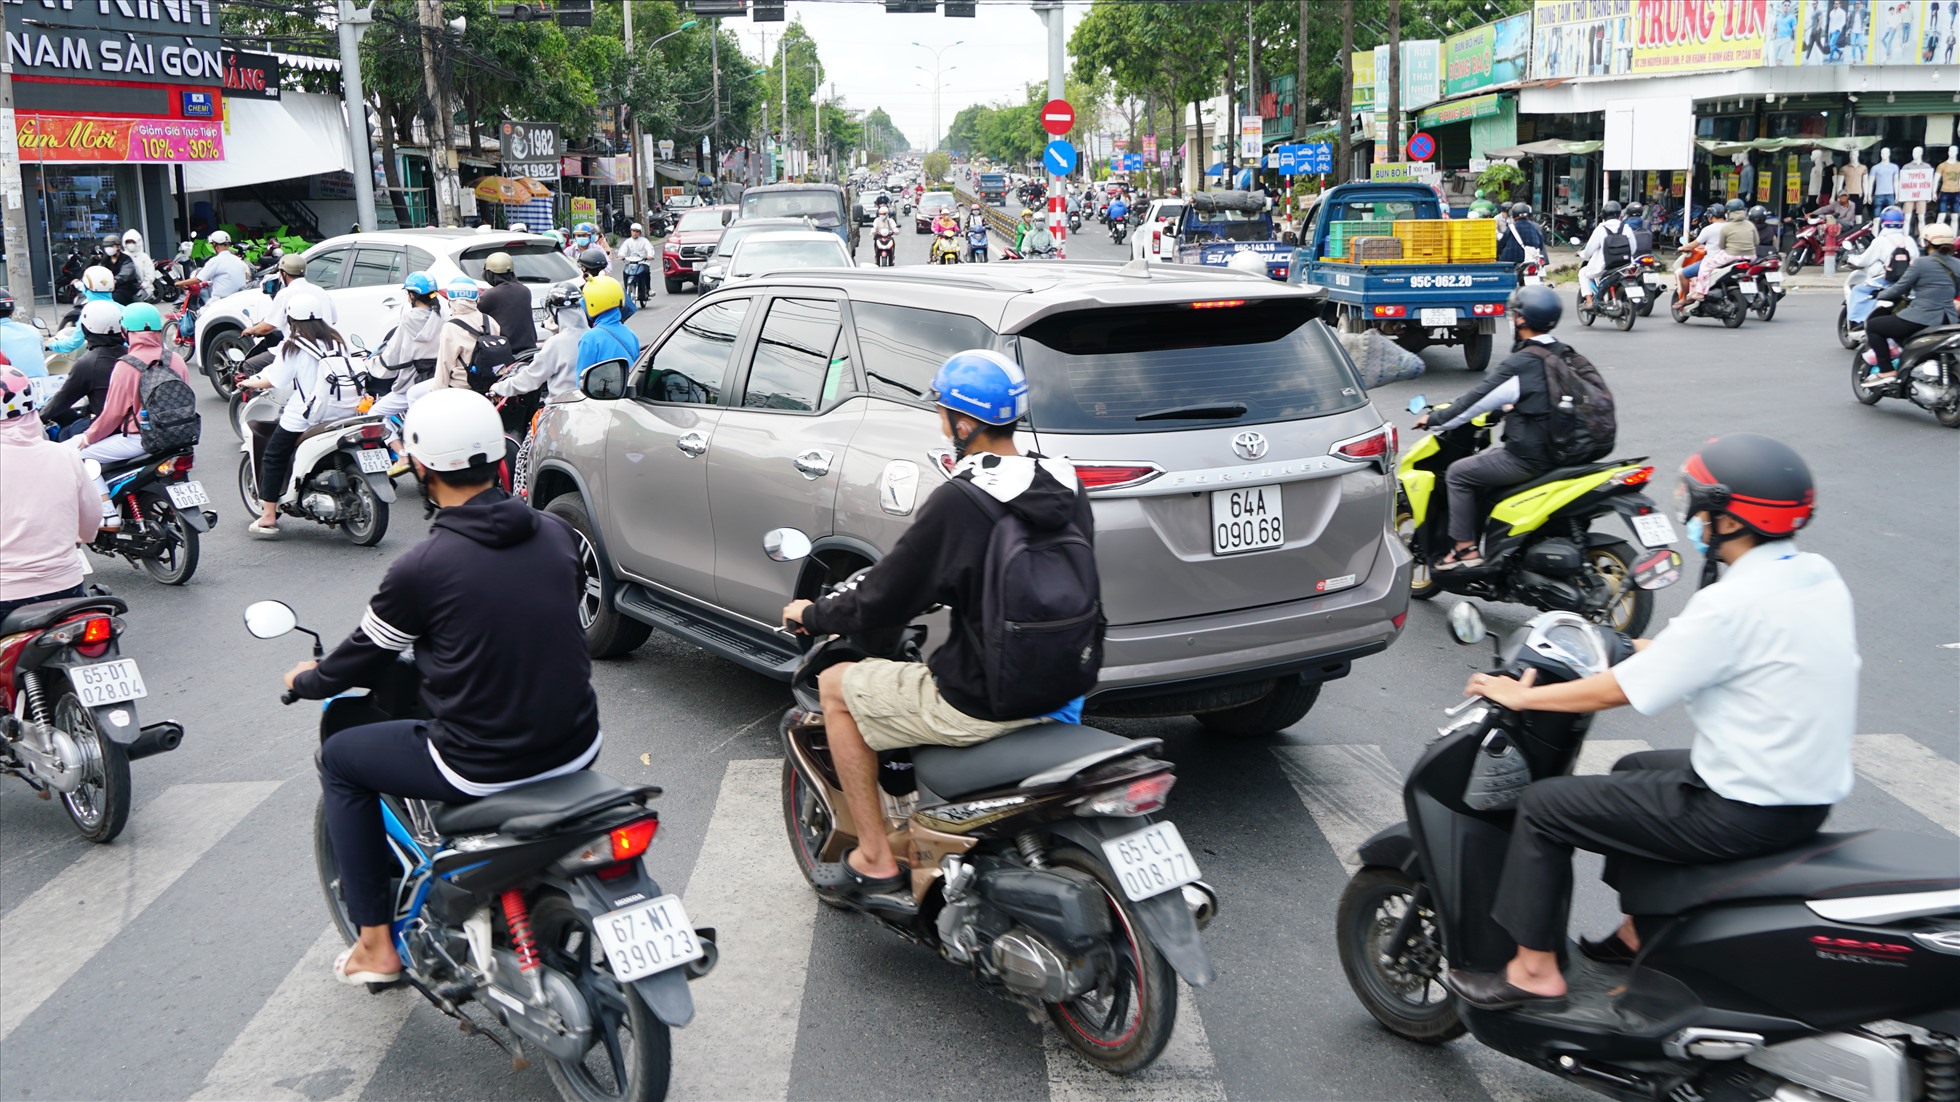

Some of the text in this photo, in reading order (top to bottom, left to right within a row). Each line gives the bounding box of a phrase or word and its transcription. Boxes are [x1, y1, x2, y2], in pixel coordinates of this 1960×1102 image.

[5, 31, 223, 78] NAM SÀI GÒN
[188, 104, 209, 112] CHEMI
[61, 121, 118, 148] Mới
[139, 124, 217, 138] Giảm Giá Trực Tiếp
[528, 128, 555, 156] 1982
[141, 138, 174, 159] 10%
[188, 139, 218, 159] 30%
[523, 163, 555, 177] 1982
[1410, 275, 1473, 288] 95C-062.20
[1172, 462, 1329, 486] FORTUNER
[1230, 489, 1267, 518] 64A
[1217, 516, 1281, 549] 090.68
[82, 663, 128, 684] 65-D1
[83, 679, 141, 703] 028.04
[1118, 830, 1171, 865] 65-C1
[1125, 853, 1193, 895] 008.77
[611, 904, 673, 945] 67-N1
[616, 928, 694, 975] 390.23
